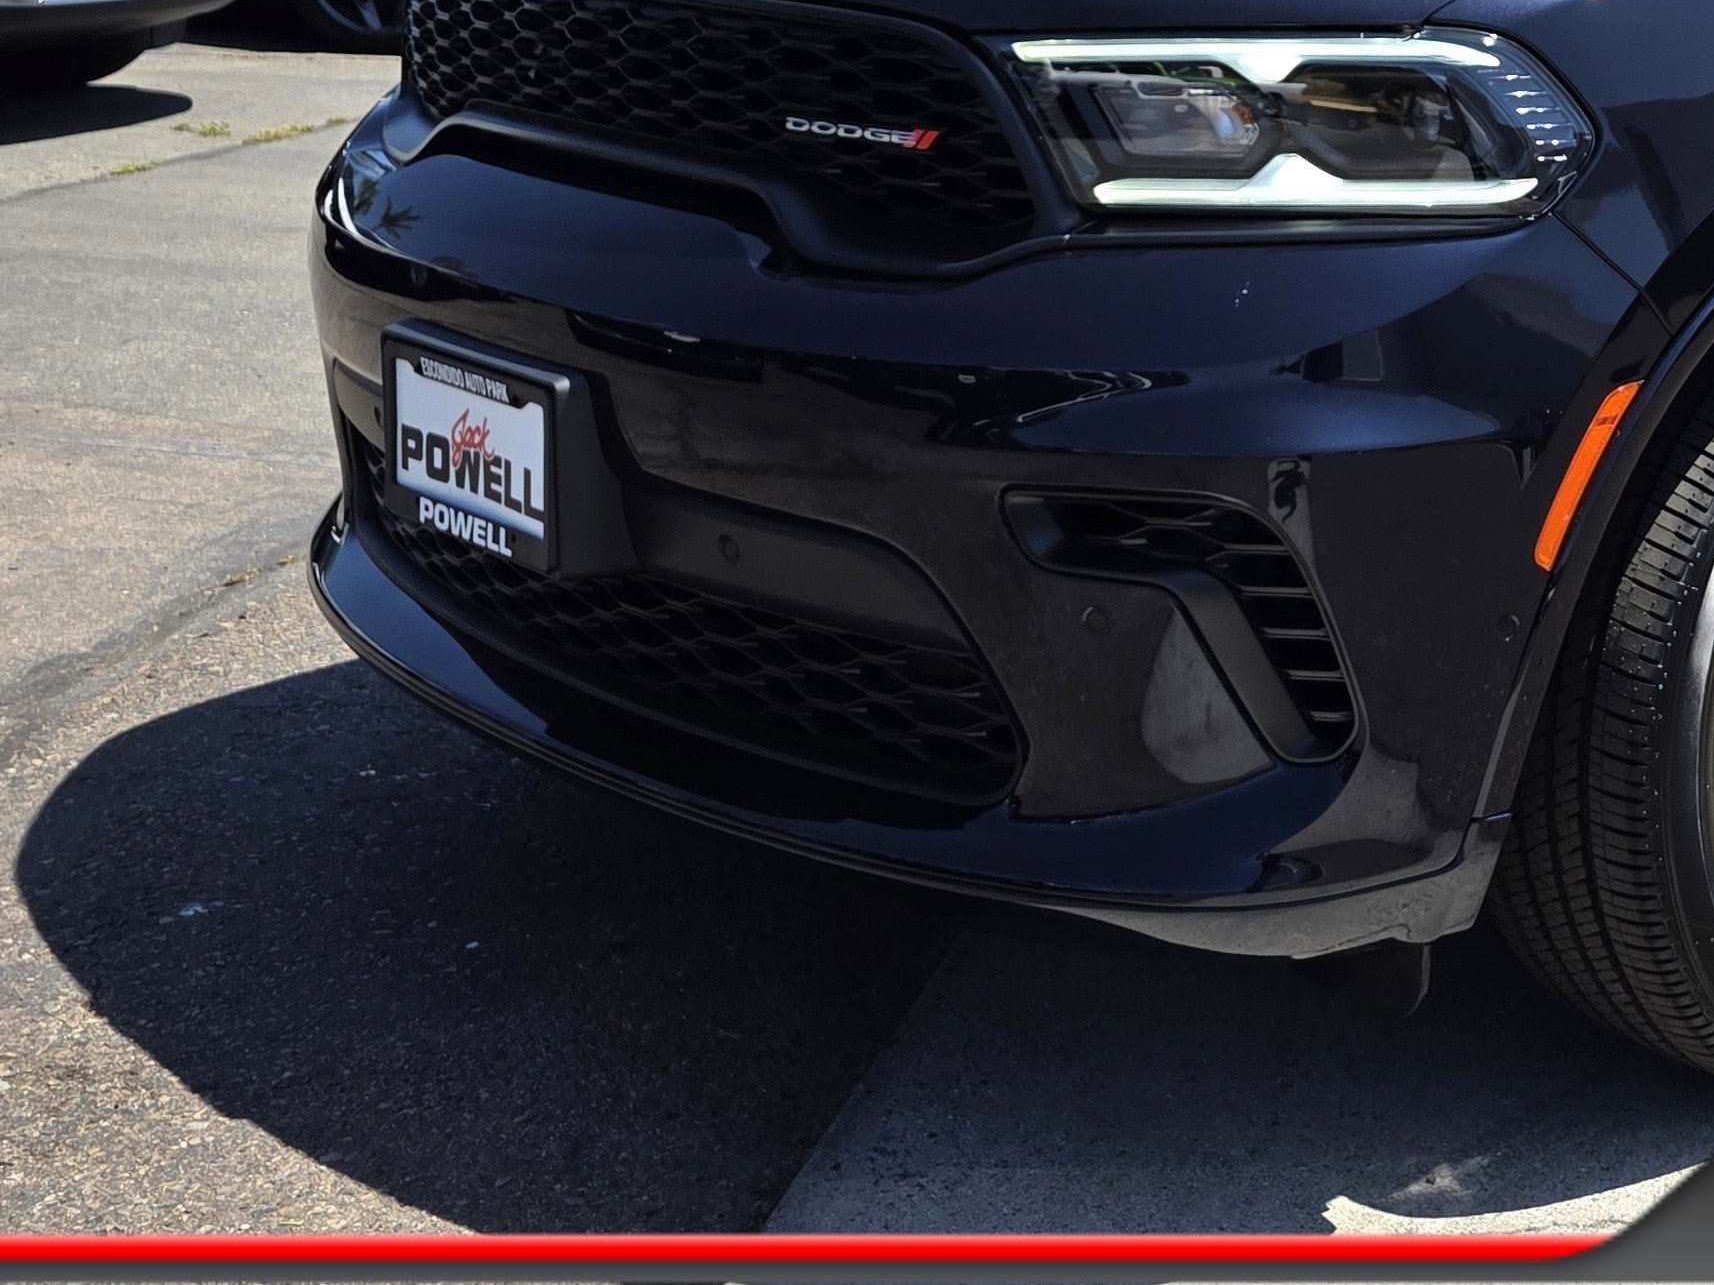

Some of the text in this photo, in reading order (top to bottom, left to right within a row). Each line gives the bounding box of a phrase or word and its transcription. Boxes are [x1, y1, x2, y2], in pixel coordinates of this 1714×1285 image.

[785, 116, 917, 145] DODGE
[419, 356, 510, 404] ESCONDIDO AUTO PARK
[451, 408, 496, 468] Jack
[401, 423, 545, 524] POWELL
[418, 495, 513, 558] POWELL
